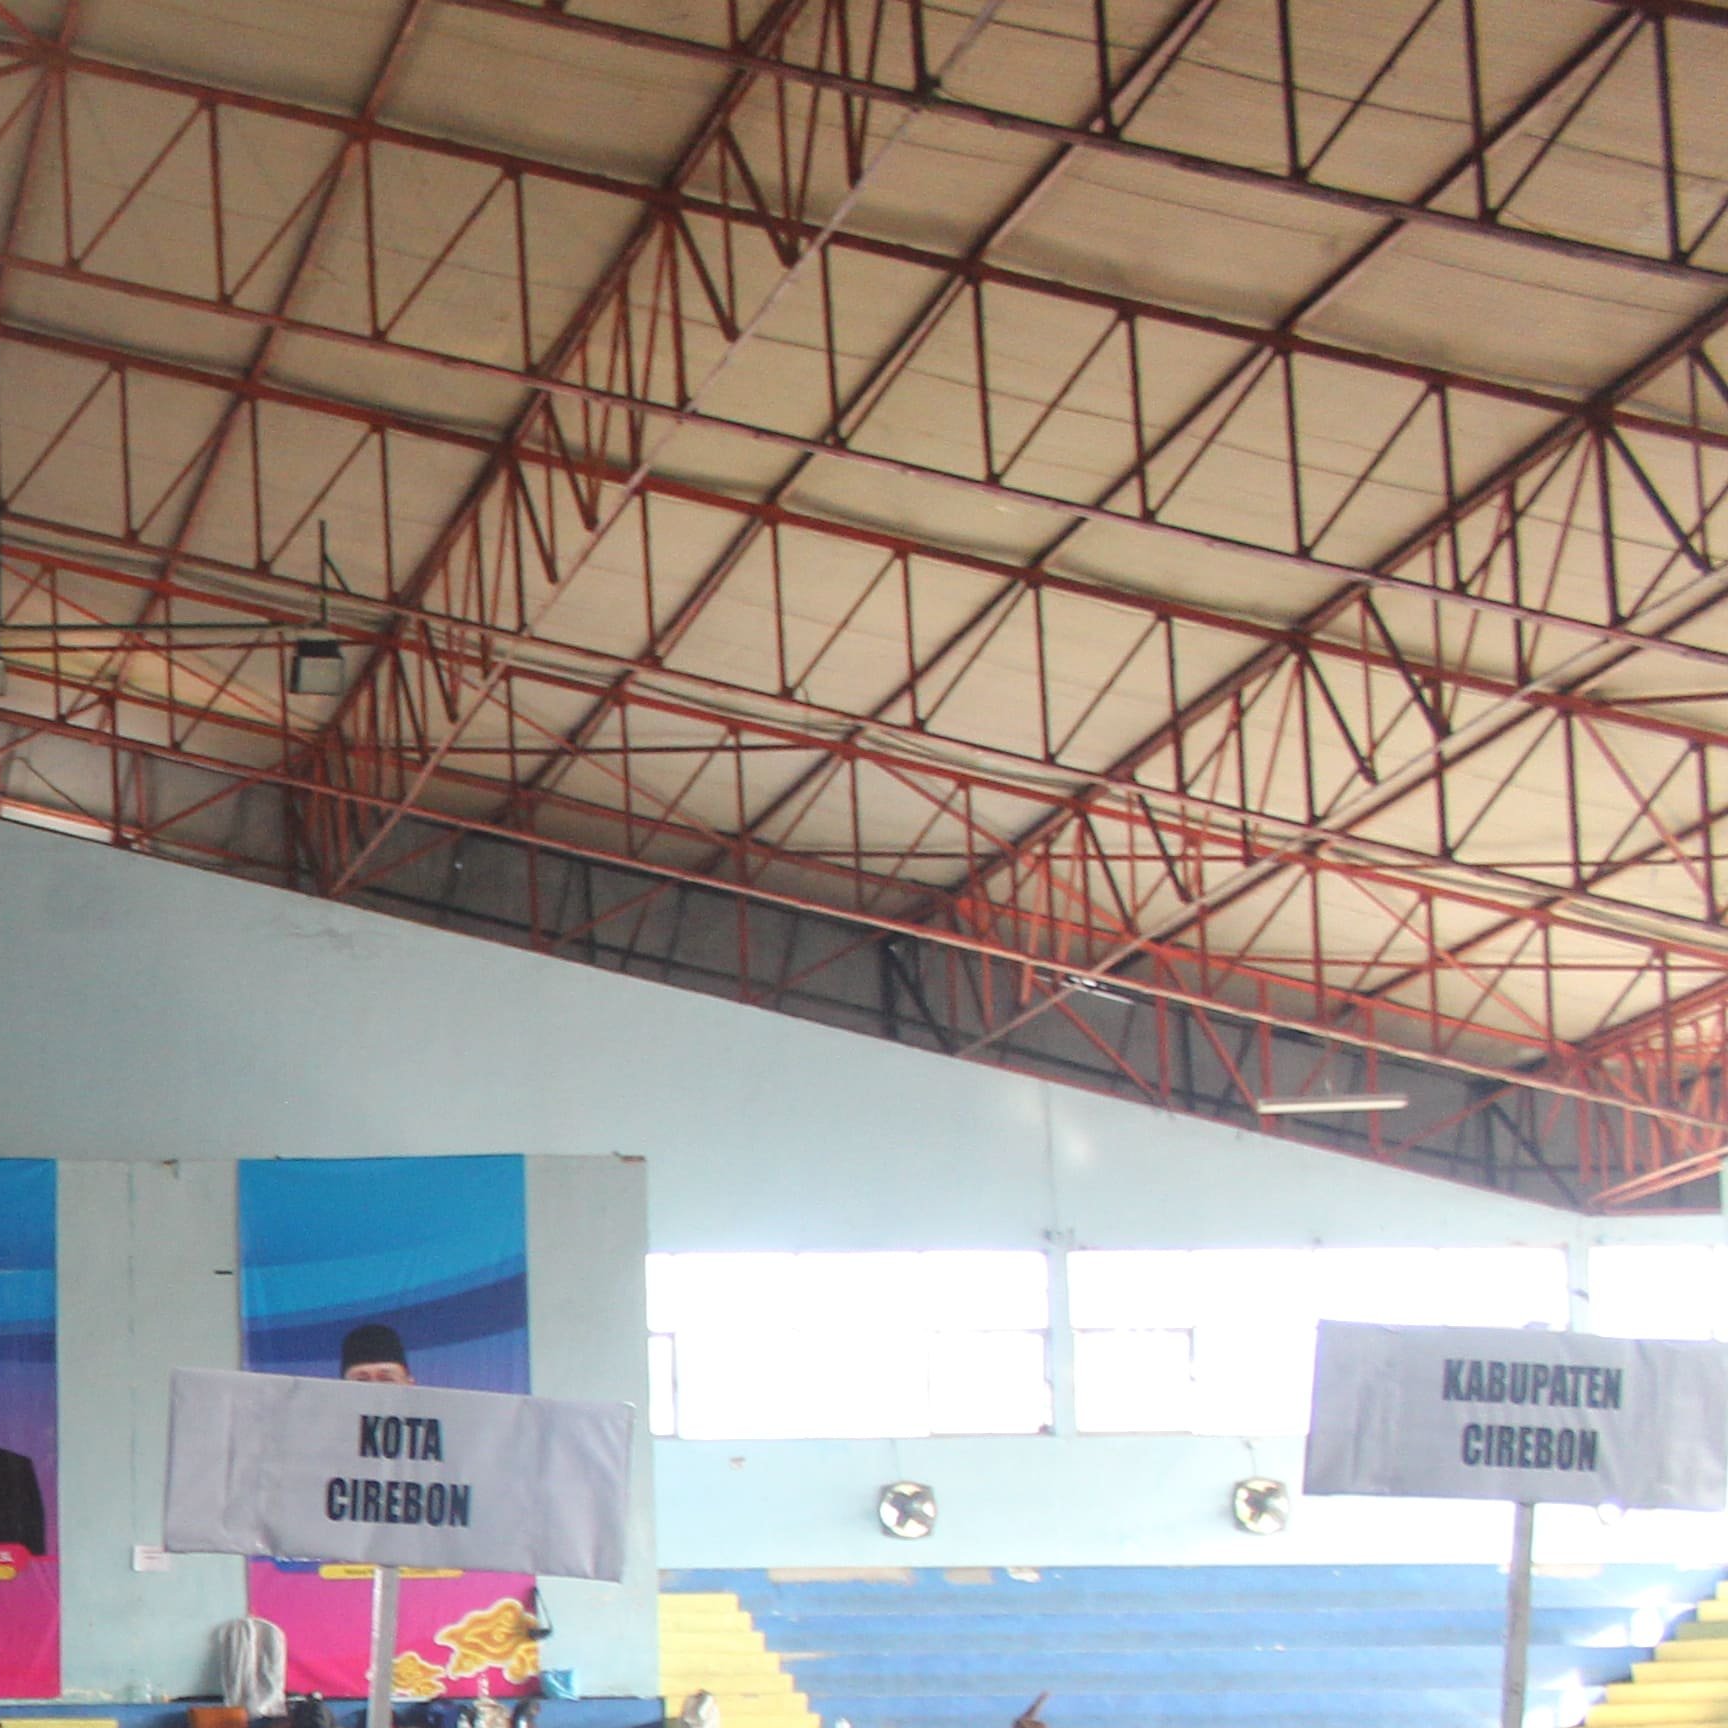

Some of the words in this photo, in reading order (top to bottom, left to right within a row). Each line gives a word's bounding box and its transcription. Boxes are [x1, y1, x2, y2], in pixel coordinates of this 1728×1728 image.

[1441, 1358, 1622, 1410] KABUPATEN
[358, 1414, 443, 1462] KOTA
[1460, 1422, 1599, 1472] CIREBON
[325, 1476, 471, 1527] CIREBON
